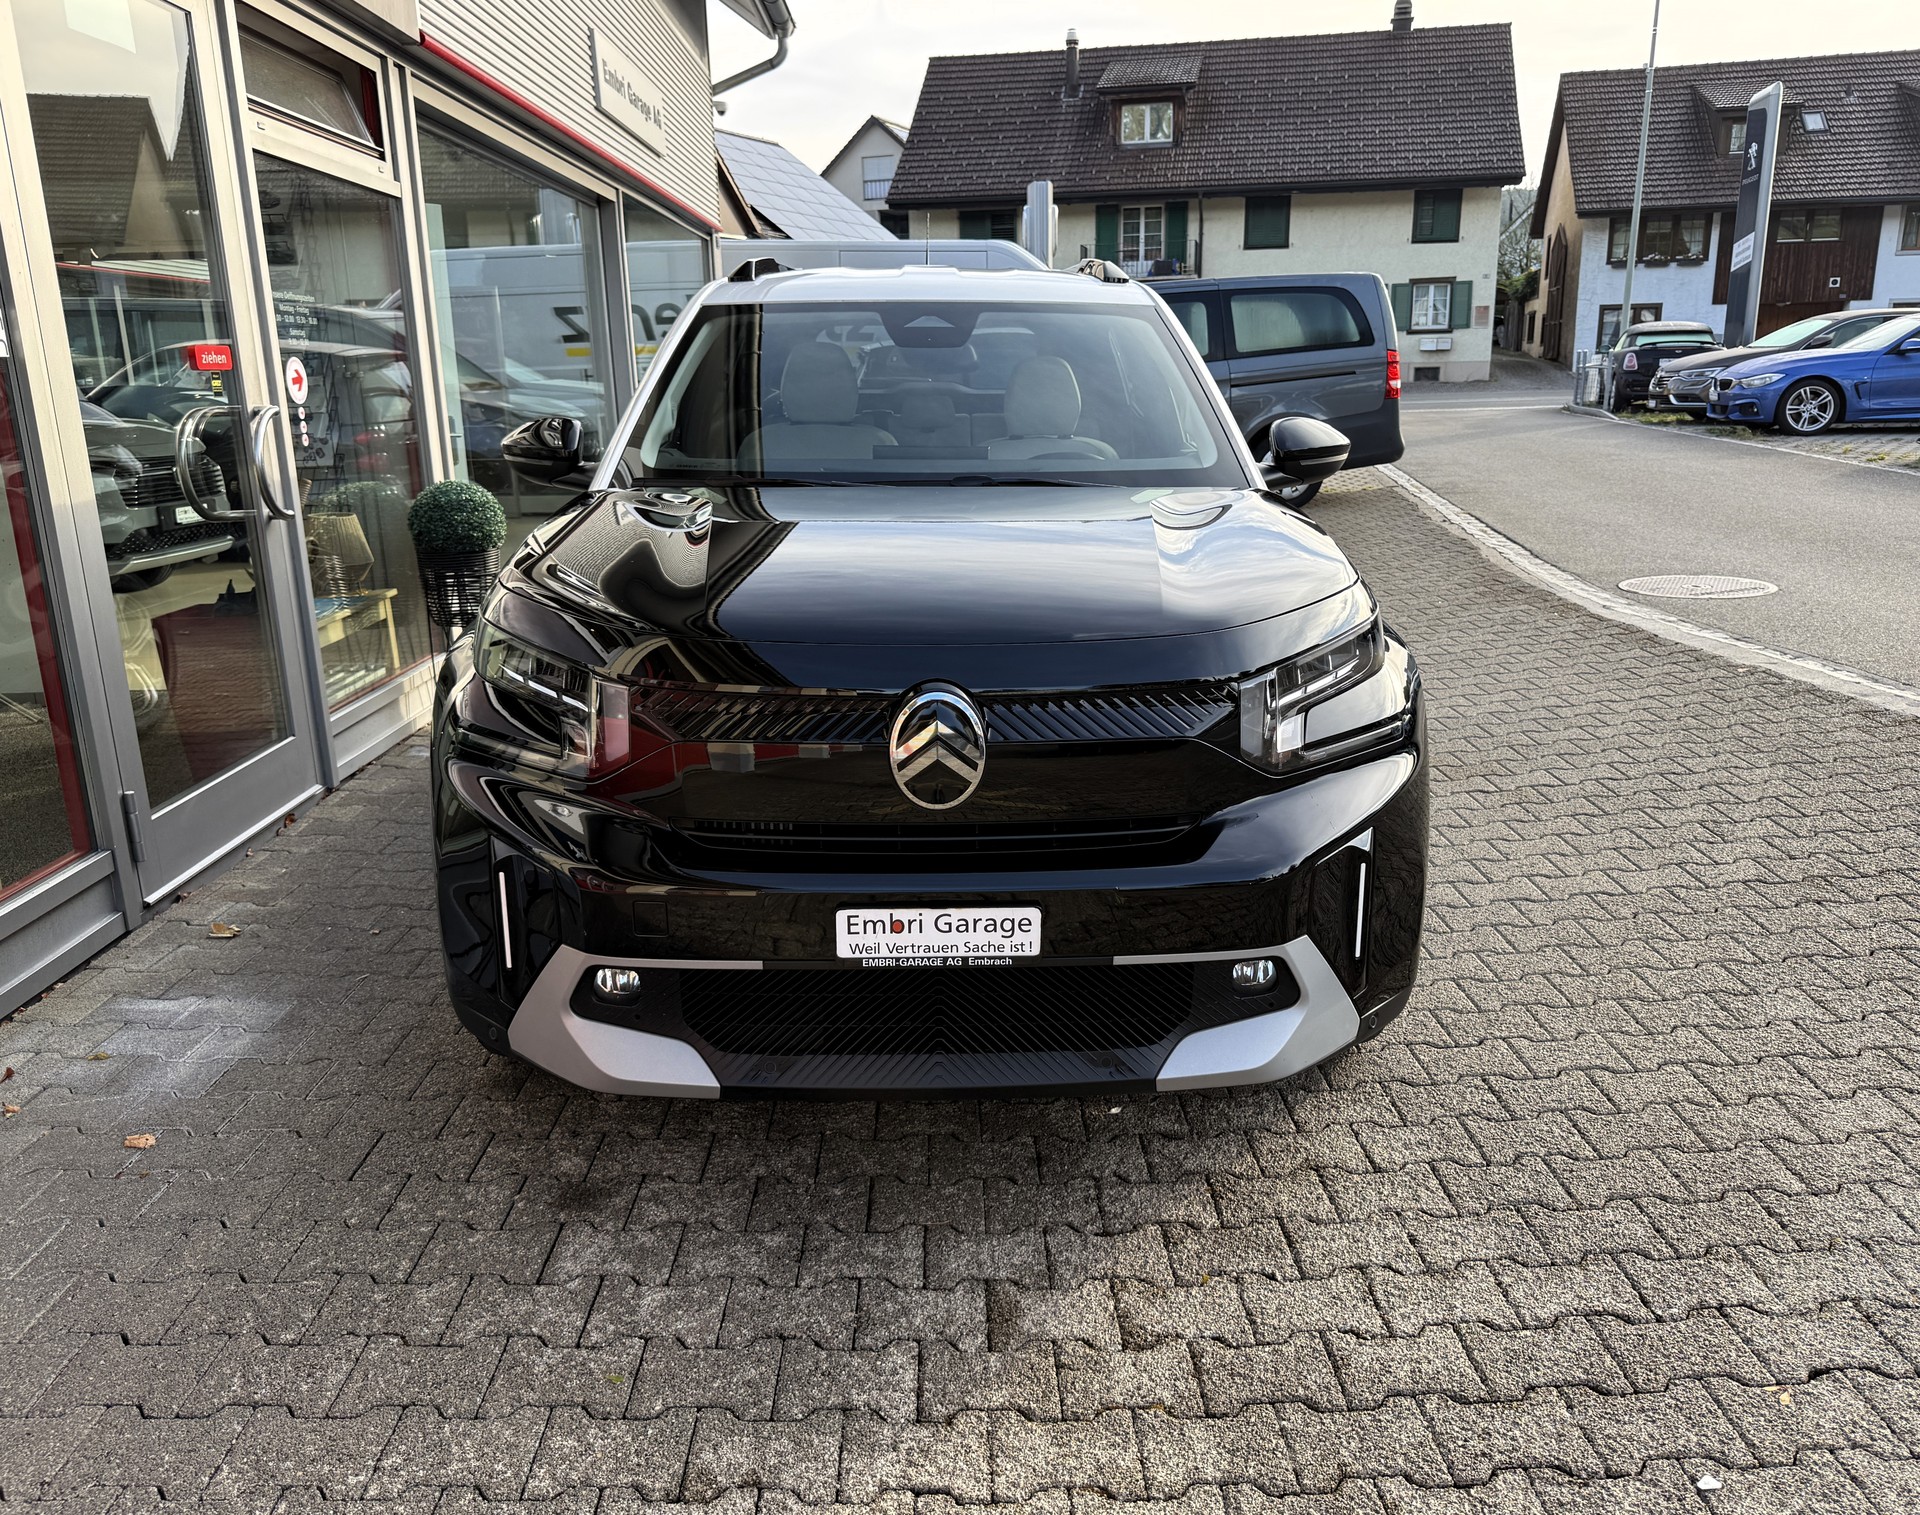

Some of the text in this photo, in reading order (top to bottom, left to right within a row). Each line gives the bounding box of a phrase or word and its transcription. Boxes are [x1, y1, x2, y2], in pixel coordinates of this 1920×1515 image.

[602, 58, 626, 99] Embri
[627, 81, 652, 122] Garage
[201, 351, 227, 364] ziehen
[846, 912, 1032, 939] Embri Garage
[849, 942, 881, 955] Weil
[886, 942, 959, 954] Vertrauen
[964, 941, 1006, 953] Sache
[862, 957, 1013, 967] EMBRI-GARAGE AG Embrach
